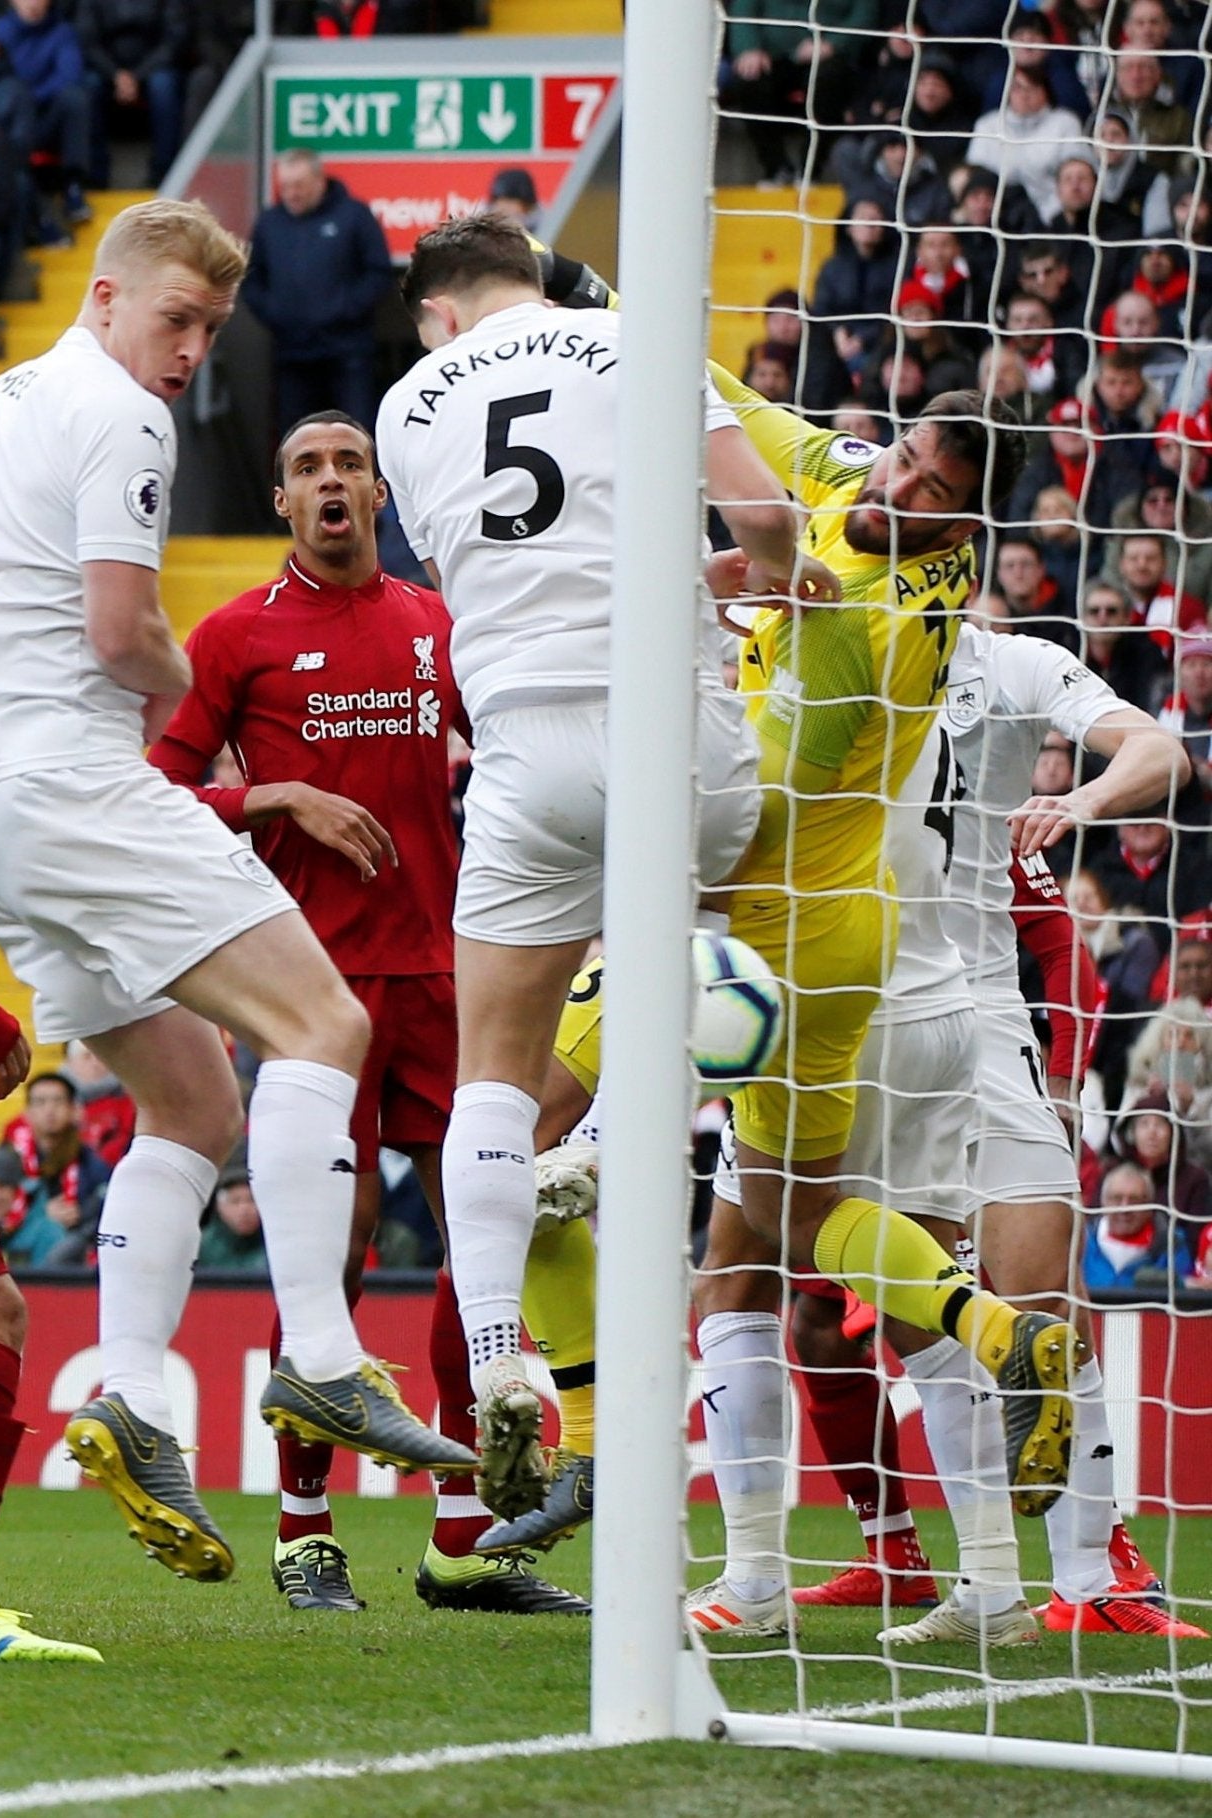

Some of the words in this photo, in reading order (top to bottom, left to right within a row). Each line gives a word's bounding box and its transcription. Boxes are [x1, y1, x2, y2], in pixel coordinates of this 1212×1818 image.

[288, 92, 401, 138] EXIT
[564, 84, 605, 142] 7
[404, 330, 619, 428] TARKOWSKI
[480, 388, 566, 542] 5
[307, 687, 412, 715] Standard
[302, 713, 412, 742] Chartered
[477, 1150, 526, 1165] BFC
